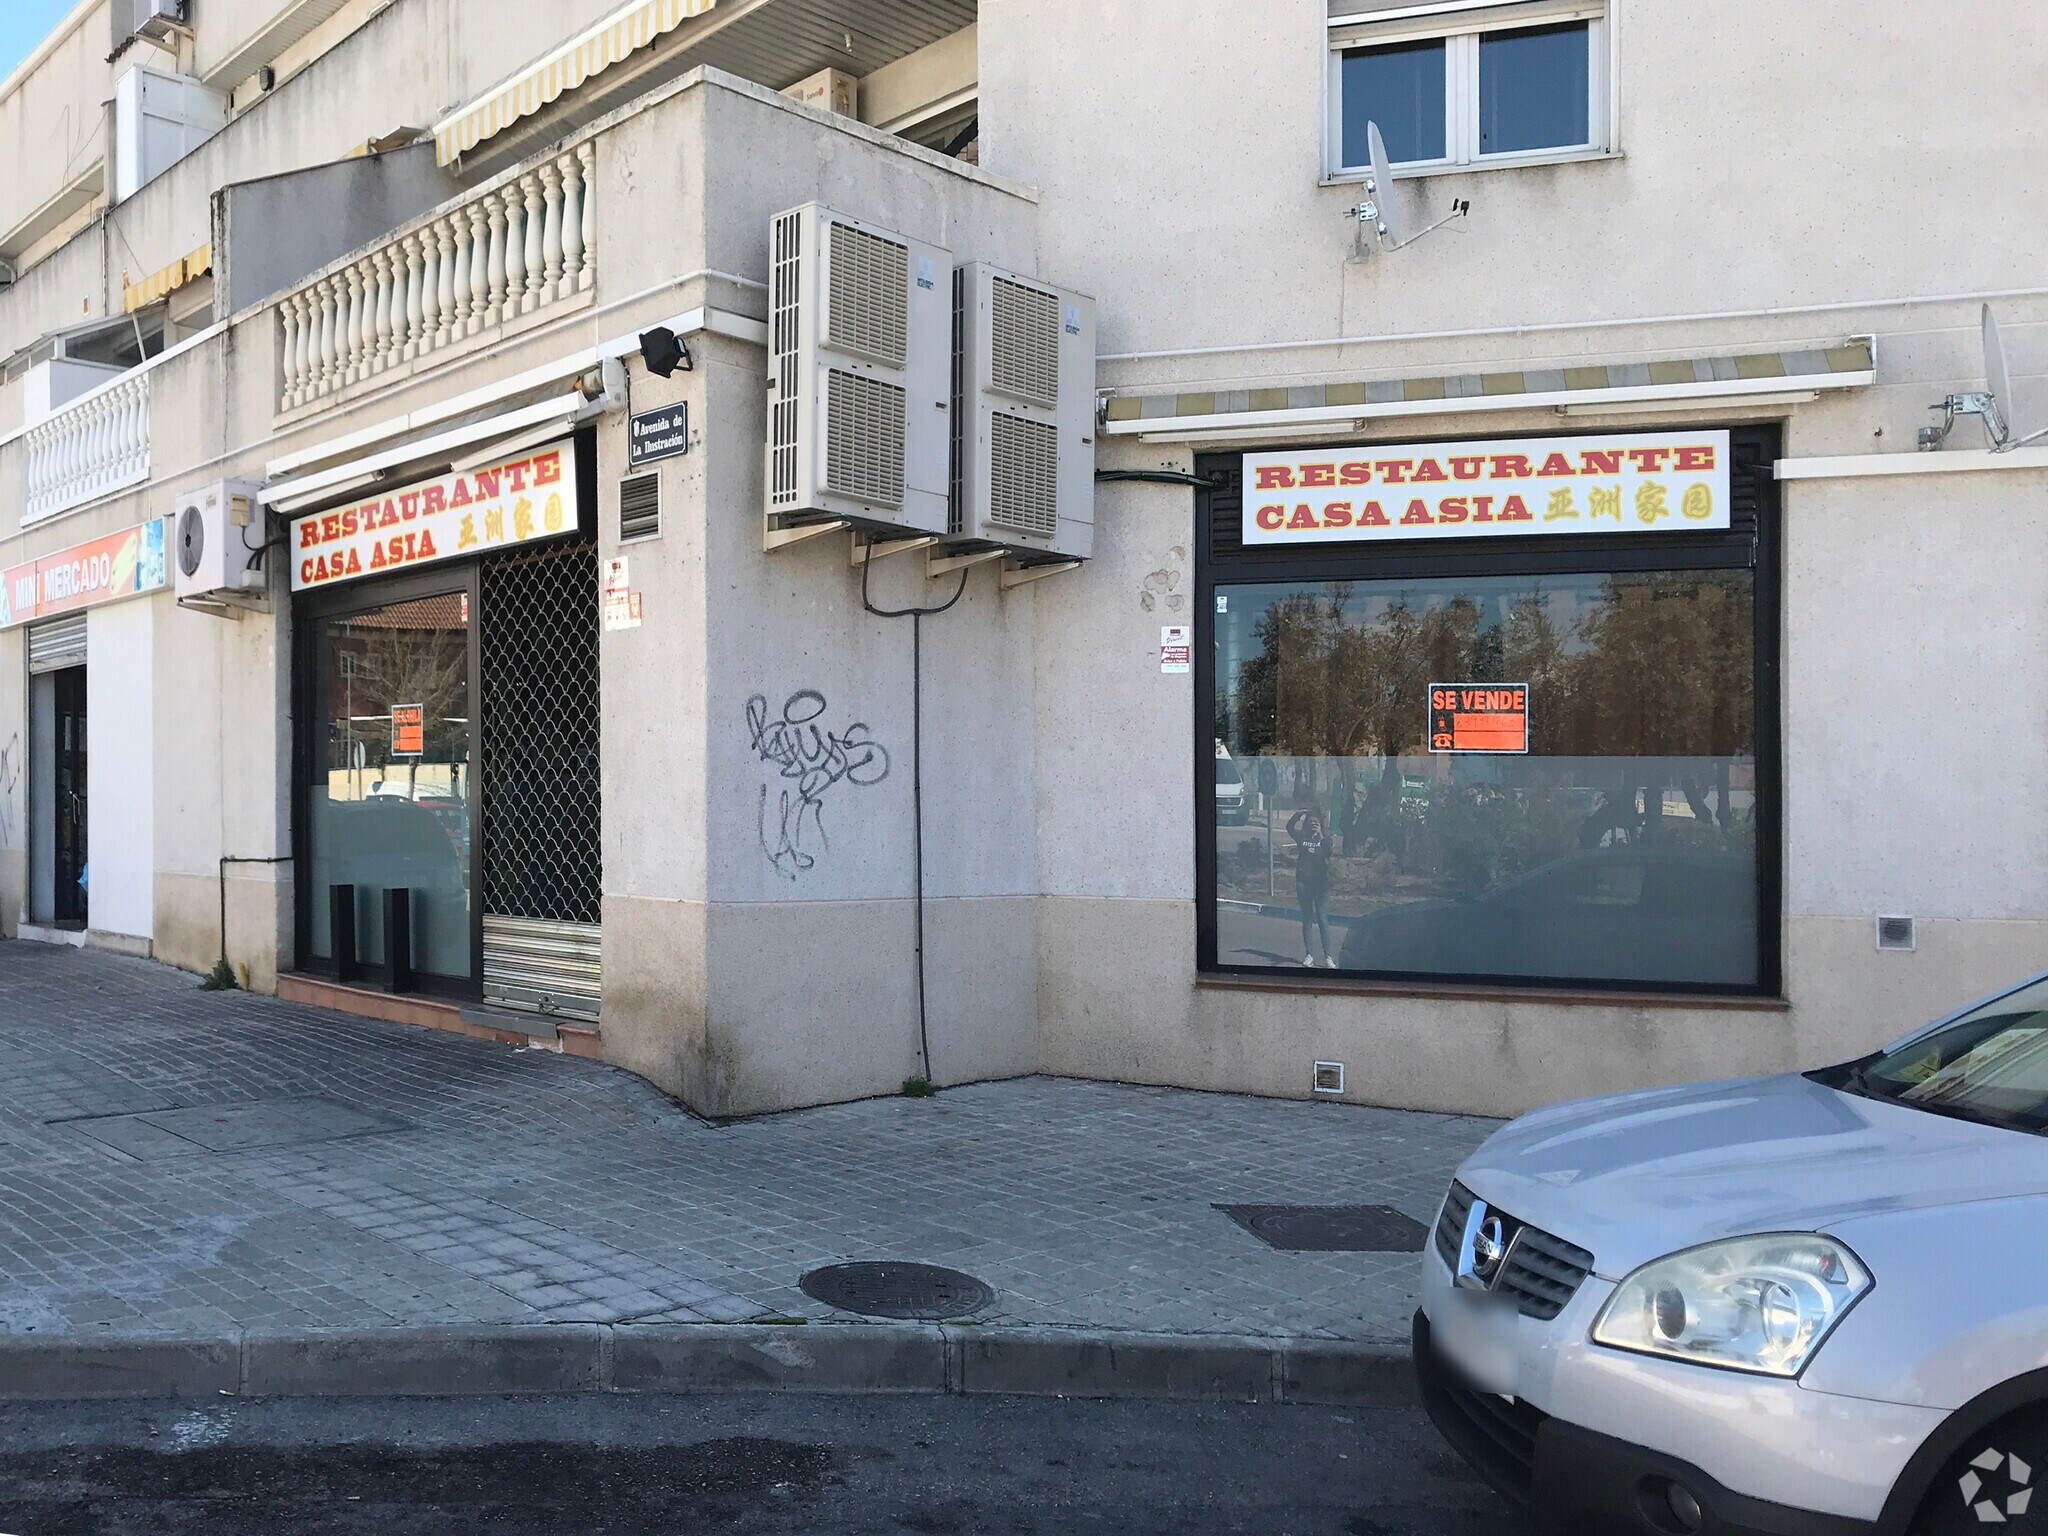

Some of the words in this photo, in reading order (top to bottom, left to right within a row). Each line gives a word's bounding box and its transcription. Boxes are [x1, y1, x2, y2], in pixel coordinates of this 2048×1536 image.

[632, 444, 642, 457] La
[644, 432, 683, 454] Ilustración
[640, 417, 670, 436] Avenida
[672, 413, 683, 427] de
[1254, 444, 1717, 491] RESTAURANTE
[299, 450, 562, 549] RESTAURANTE
[1255, 499, 1391, 531] CASA
[1399, 494, 1534, 526] ASIA
[300, 547, 362, 585] CASA
[369, 527, 437, 570] ASIA
[15, 572, 41, 611] MINI
[44, 551, 110, 603] MERCADO
[1432, 690, 1457, 710] SE
[1461, 690, 1525, 710] VENDE
